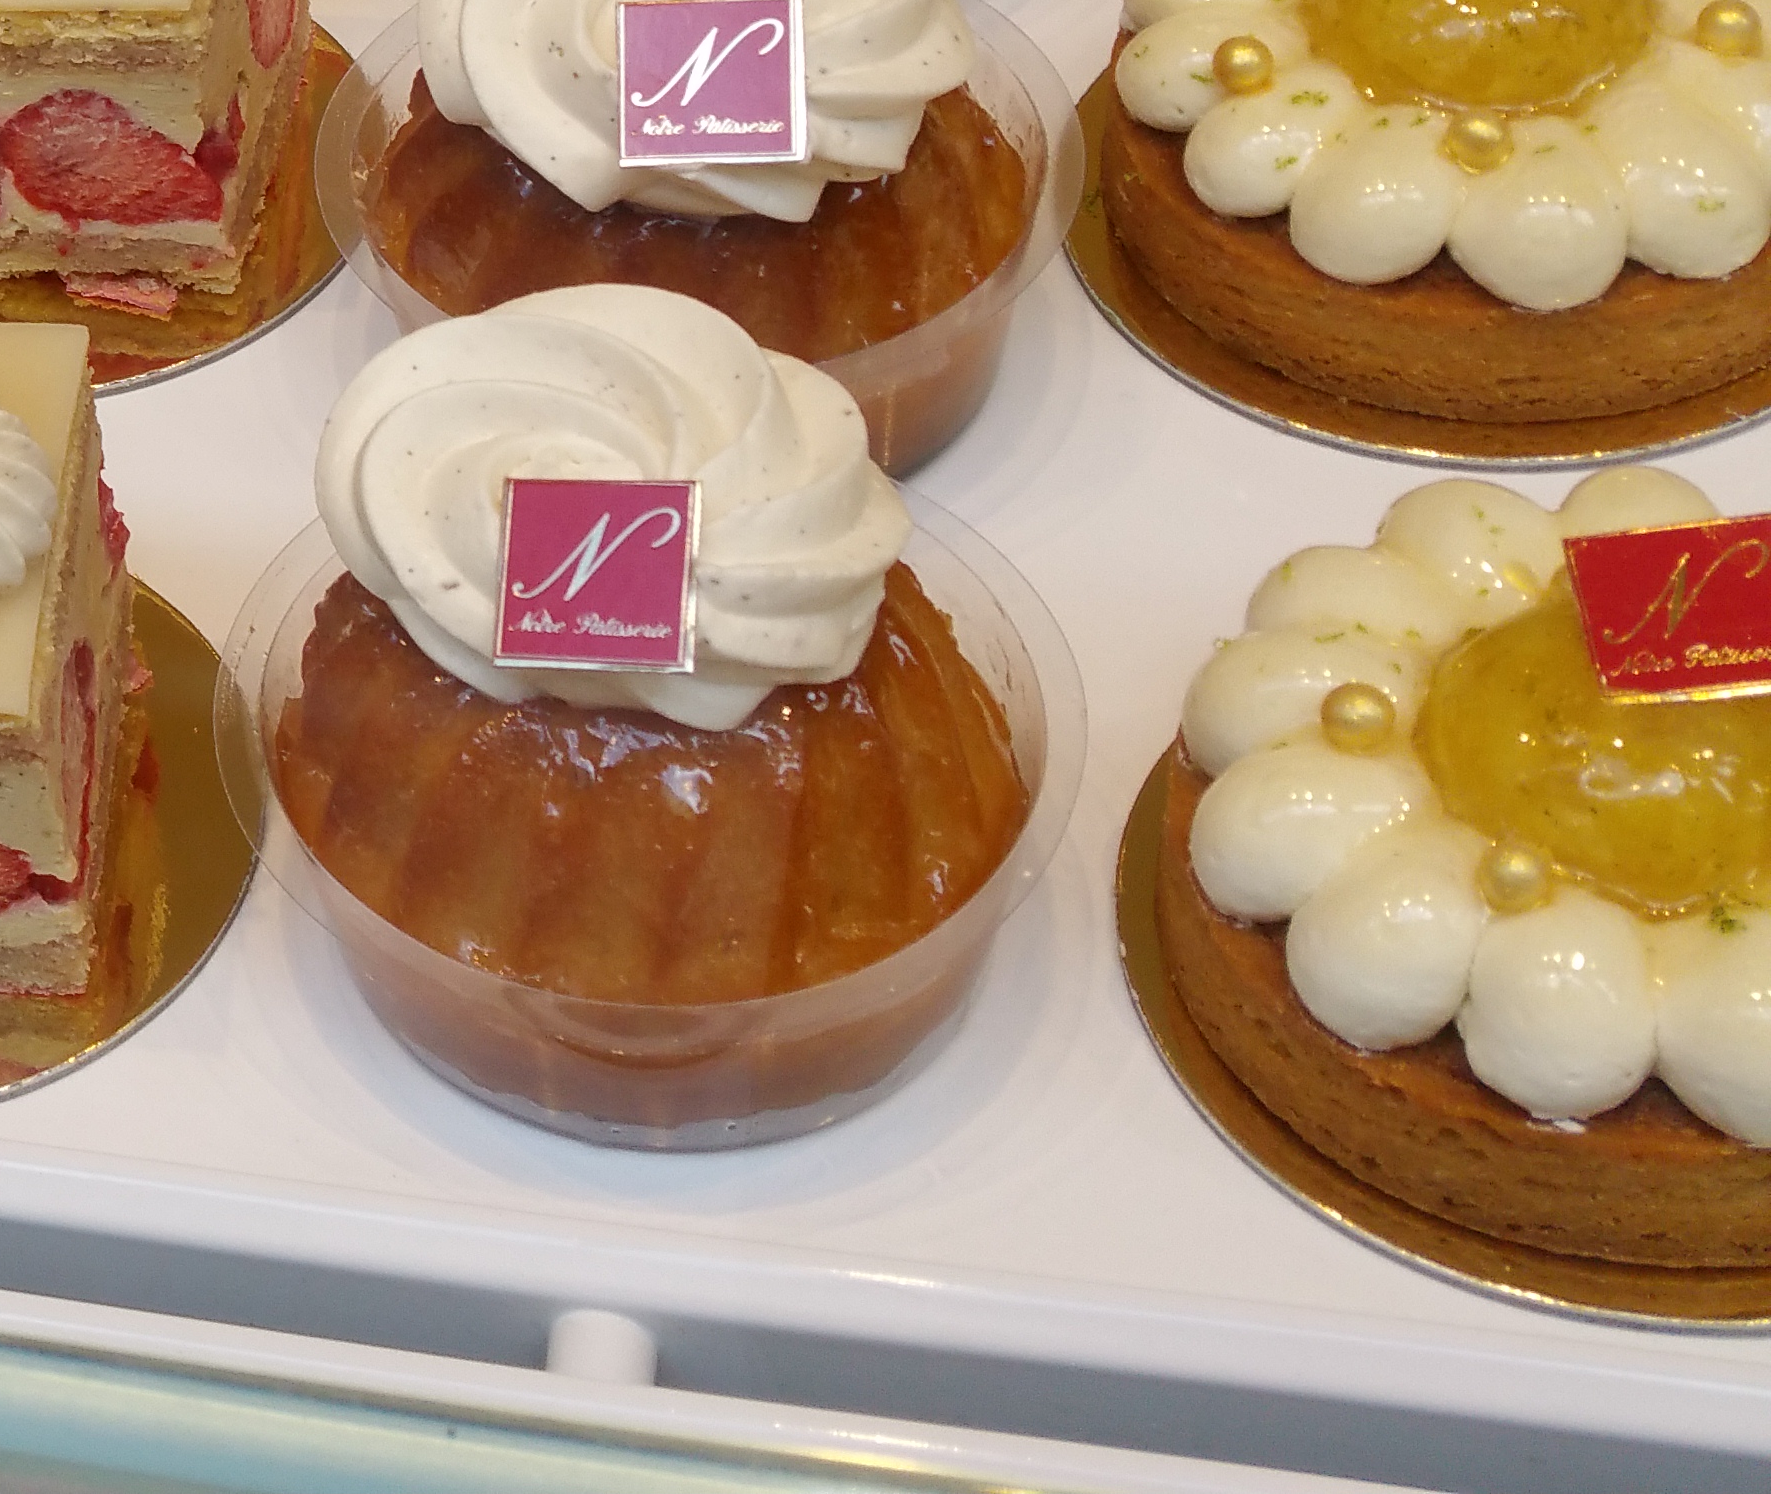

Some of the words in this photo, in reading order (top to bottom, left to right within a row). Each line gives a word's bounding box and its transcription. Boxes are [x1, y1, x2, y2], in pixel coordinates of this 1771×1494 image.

[631, 18, 784, 107] N
[512, 508, 682, 601] N
[1603, 539, 1771, 640] N
